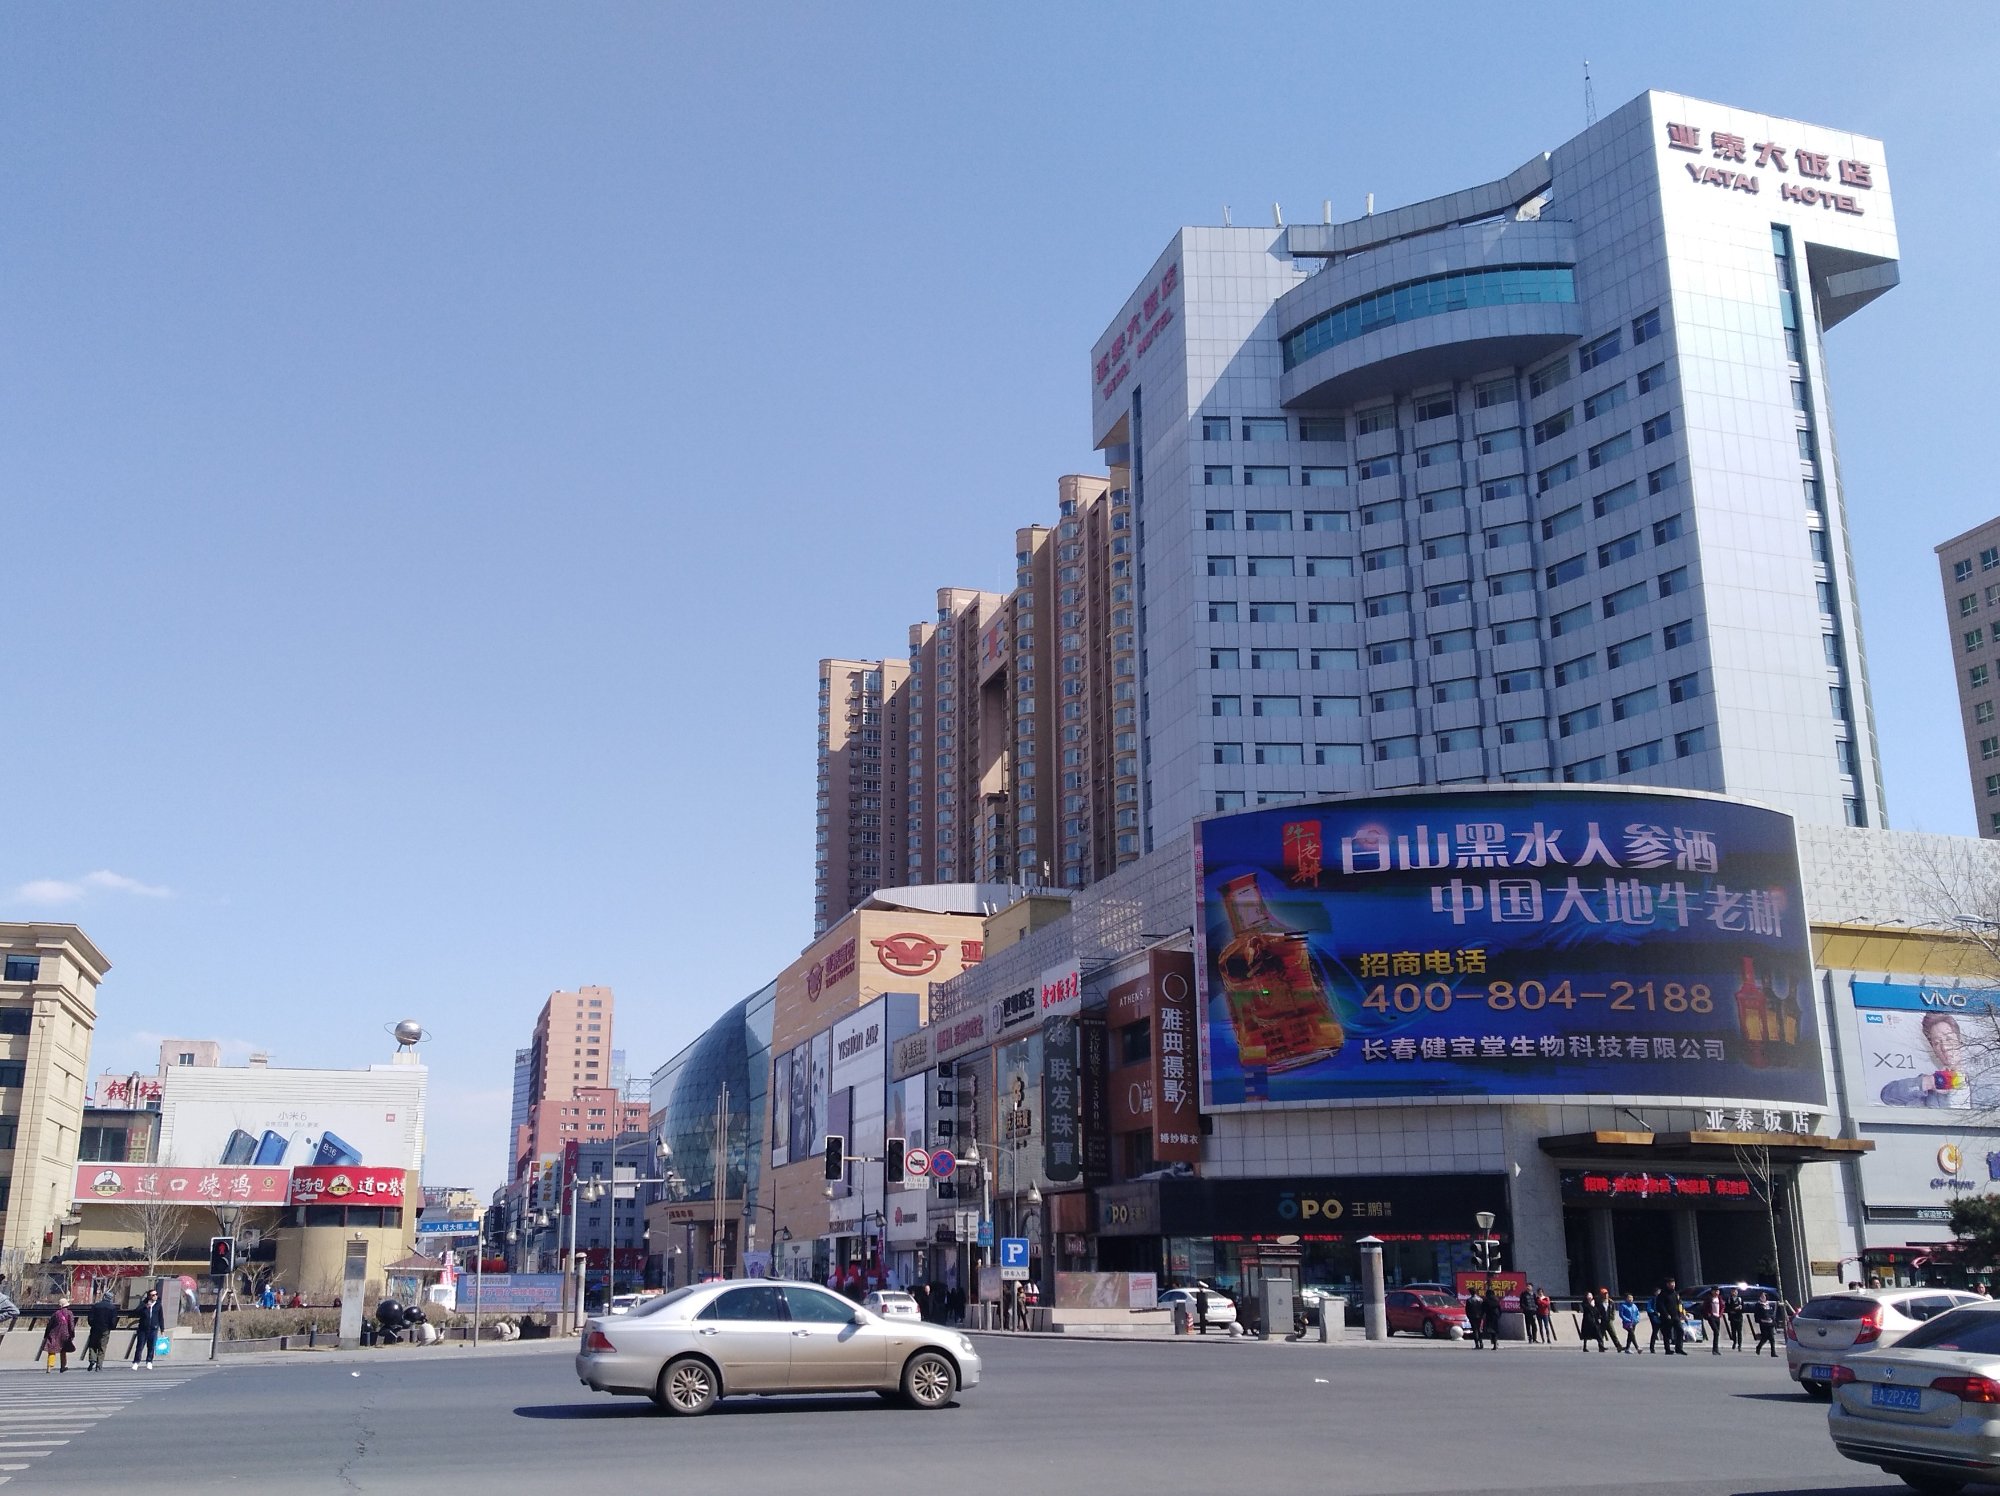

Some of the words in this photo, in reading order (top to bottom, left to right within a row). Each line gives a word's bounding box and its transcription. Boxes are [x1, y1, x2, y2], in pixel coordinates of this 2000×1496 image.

[1666, 121, 1872, 189] 亚泰大饭店
[1685, 162, 1759, 194] YATAI
[1780, 182, 1864, 216] HOTEL
[1096, 262, 1178, 385] 亚泰大饭店
[1341, 822, 1719, 876] 白山黑水人参酒
[1431, 876, 1783, 938] 中国大地牛老耕
[1359, 949, 1487, 978] 招商电话
[1119, 991, 1144, 1008] ATHENS
[1361, 980, 1715, 1013] 400-804-2188
[1161, 1007, 1187, 1114] 雅典摄影
[1361, 1035, 1726, 1062] 长春健宝堂生物科技有限公司
[1873, 1051, 1917, 1070] X21
[1705, 1108, 1810, 1133] 亚泰饭店
[1160, 1132, 1199, 1145] 婚纱嫁衣
[435, 1223, 464, 1232] 人民大街
[1007, 1243, 1024, 1263] P
